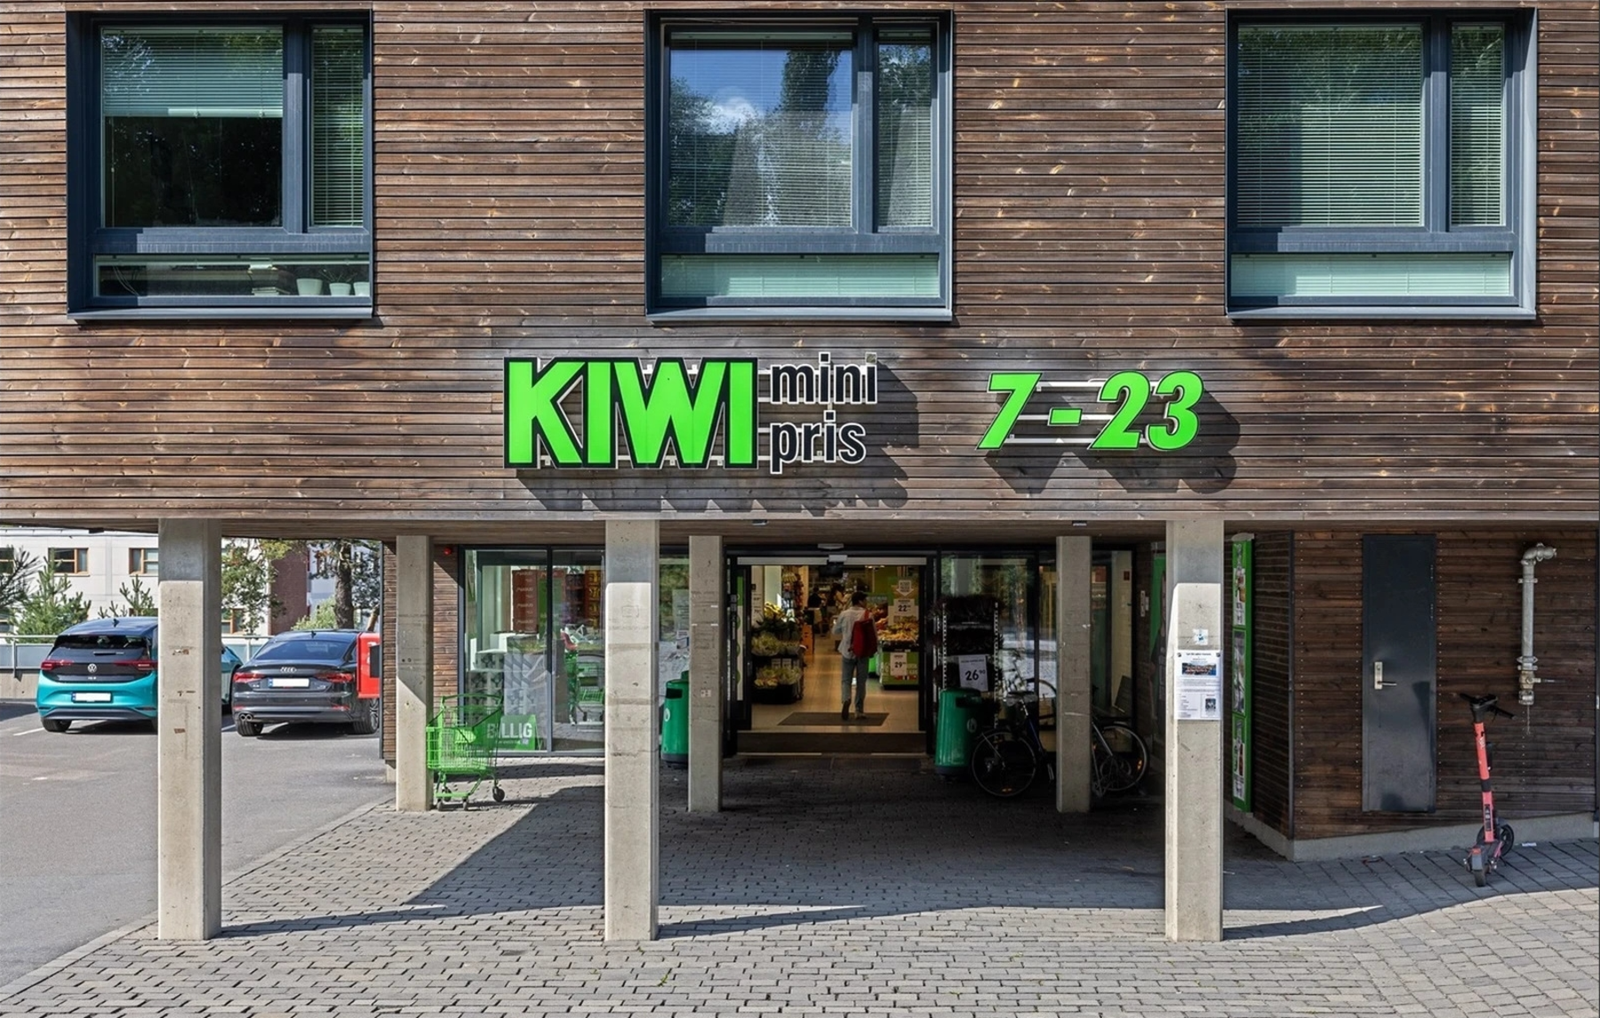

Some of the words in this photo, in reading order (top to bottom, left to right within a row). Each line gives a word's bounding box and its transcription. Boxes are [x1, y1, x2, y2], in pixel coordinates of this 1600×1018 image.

[770, 352, 877, 404] mini
[504, 357, 759, 469] KIWI
[770, 410, 866, 474] pris
[976, 372, 1043, 450] 7
[1087, 370, 1204, 451] 23
[965, 669, 979, 681] 26
